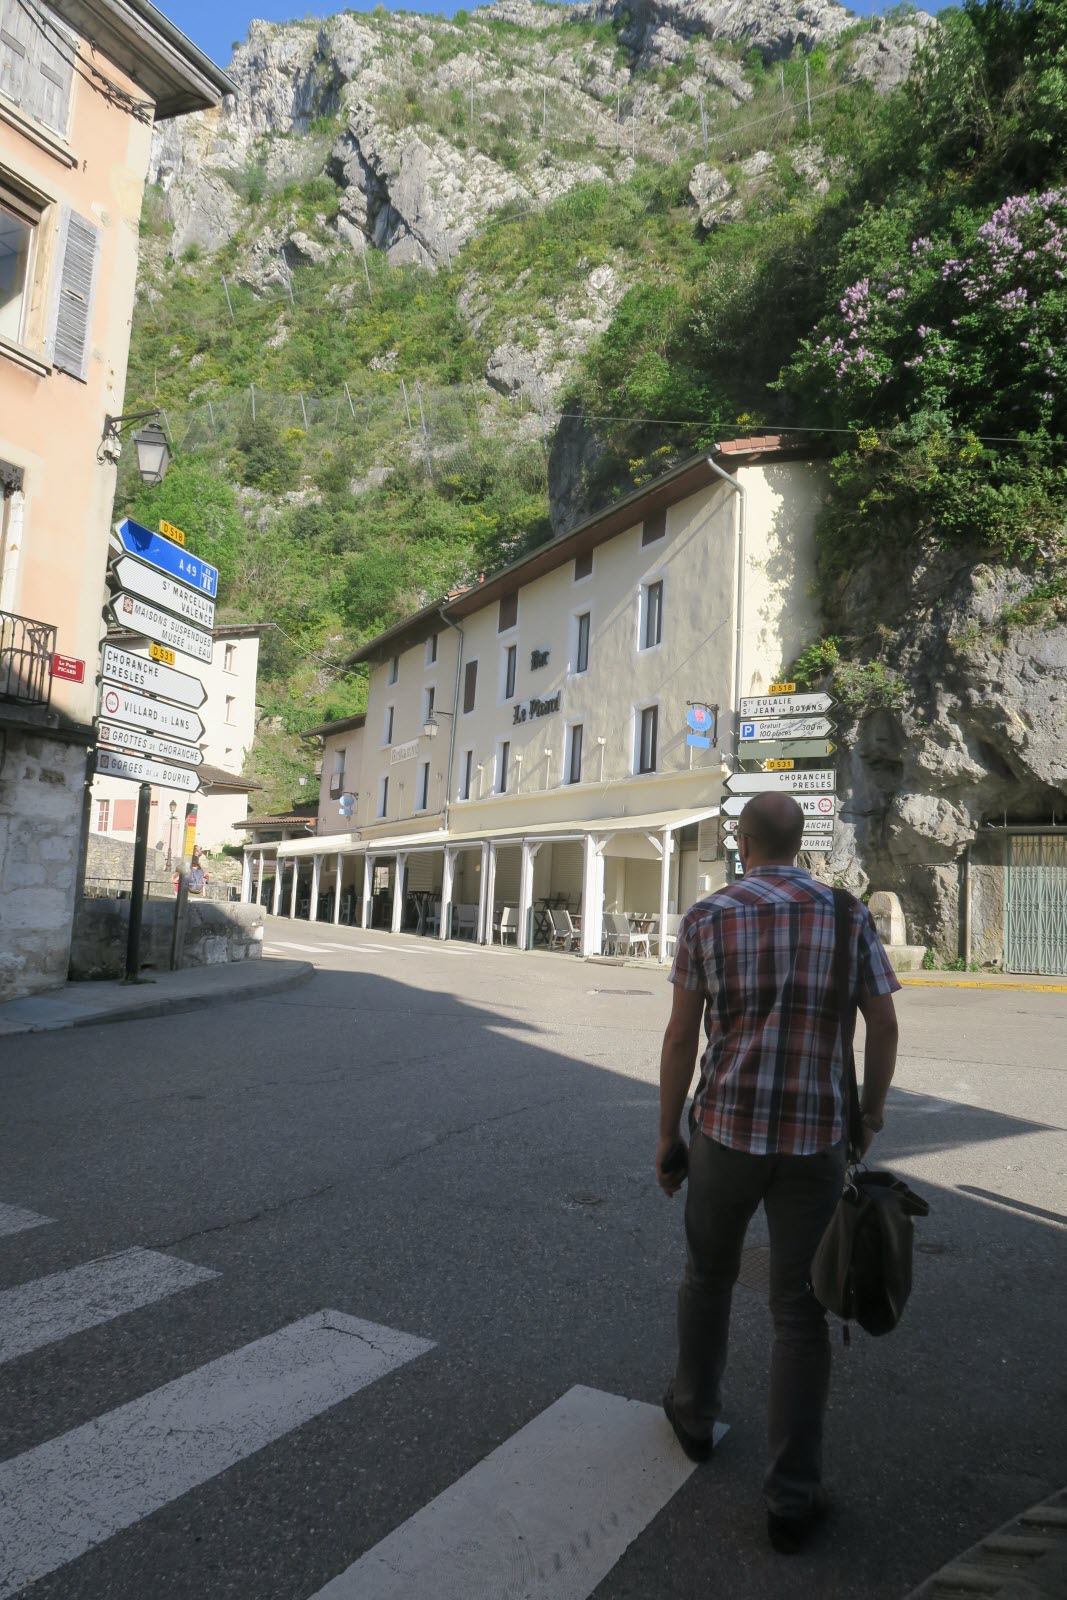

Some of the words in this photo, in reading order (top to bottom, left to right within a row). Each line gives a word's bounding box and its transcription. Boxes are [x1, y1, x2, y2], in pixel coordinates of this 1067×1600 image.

[163, 523, 168, 533] D
[170, 527, 183, 542] 518
[179, 558, 184, 570] A
[186, 563, 197, 577] 49
[173, 586, 213, 614] MARCELLIN
[181, 602, 212, 626] VALENCE
[134, 604, 168, 627] MAISONS
[170, 621, 211, 648] SUSPENDUES
[153, 646, 158, 656] D
[160, 649, 173, 662] 531
[198, 647, 211, 659] EAU
[107, 650, 159, 678] CHORANCHE
[105, 663, 145, 685] PRESLES
[753, 706, 775, 714] JEAN
[789, 703, 823, 713] ROYANS
[757, 697, 792, 706] EULALIE
[124, 701, 158, 720] VILLARD
[161, 716, 168, 724] DE
[170, 716, 190, 729] LANS
[759, 722, 781, 730] Gratuit
[771, 730, 792, 739] places
[112, 730, 148, 749] GROTTES
[158, 742, 199, 761] CHORANCHE
[111, 758, 143, 774] GORGES
[162, 770, 190, 785] BOURNE
[779, 772, 832, 781] CHORANCHE
[792, 781, 832, 789] PRESLES
[803, 839, 831, 847] OURNE
